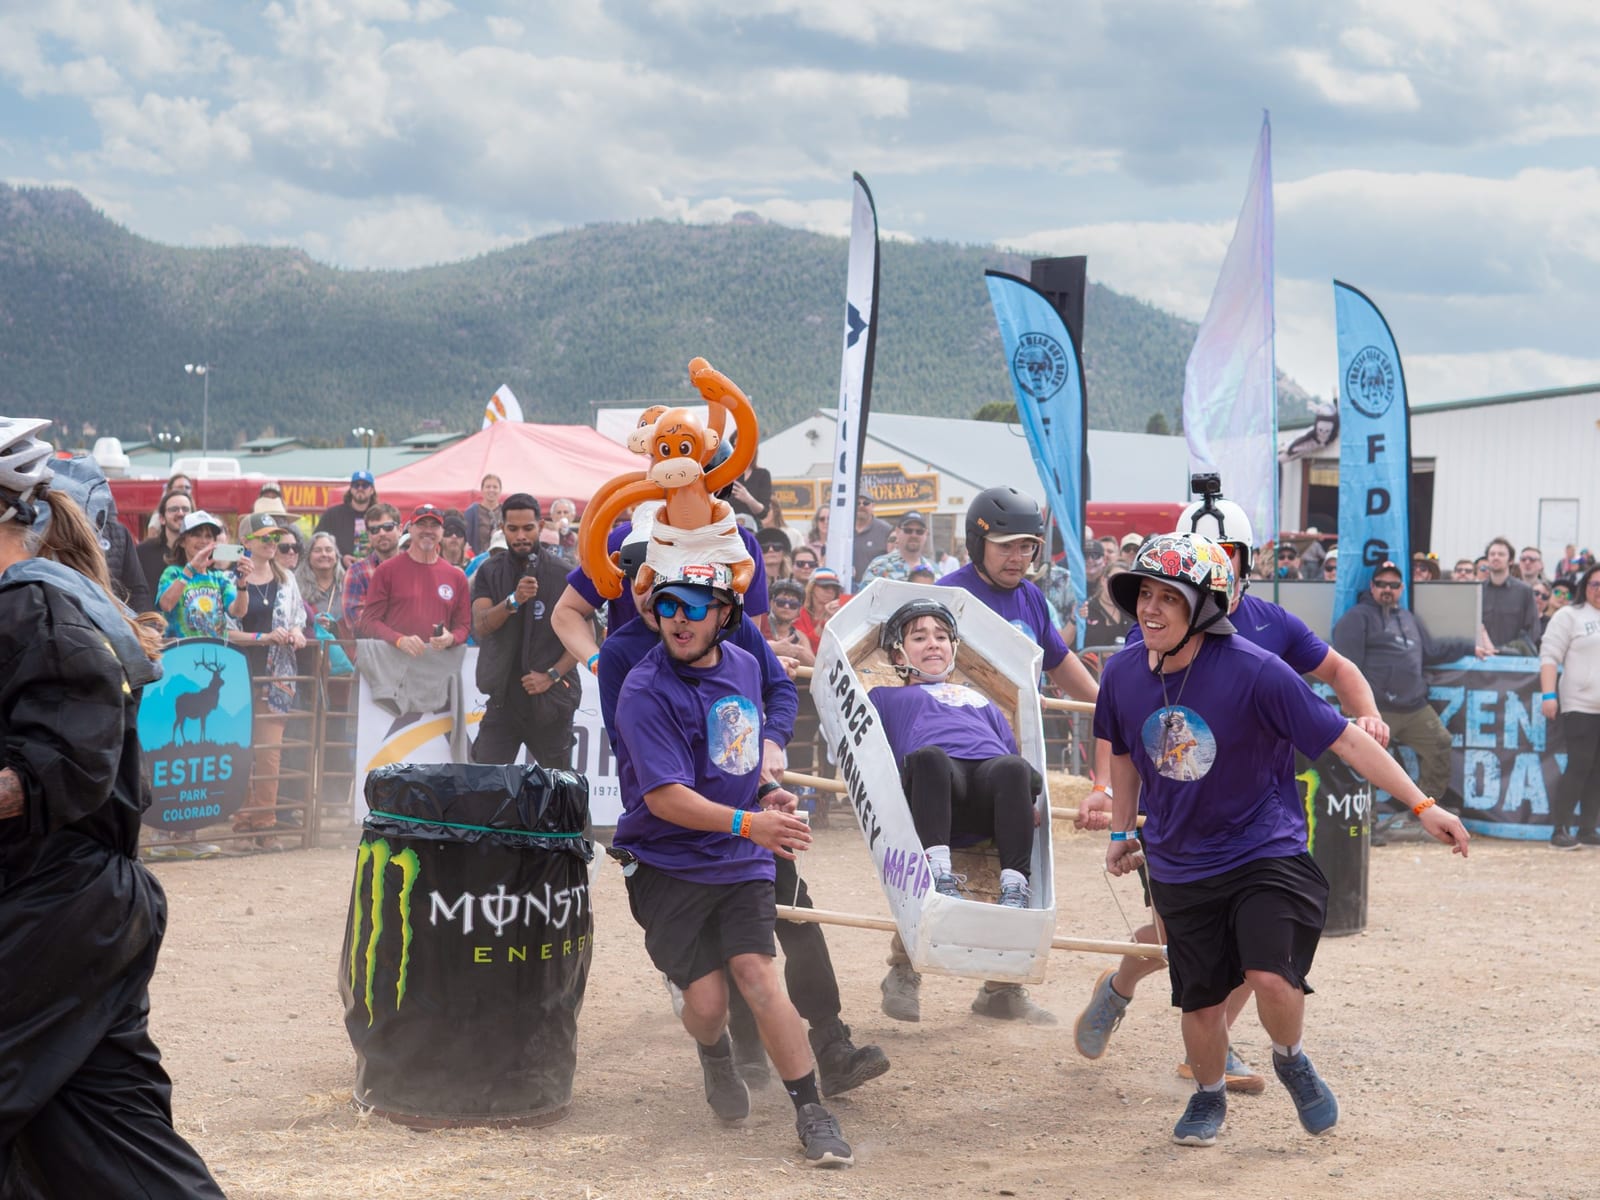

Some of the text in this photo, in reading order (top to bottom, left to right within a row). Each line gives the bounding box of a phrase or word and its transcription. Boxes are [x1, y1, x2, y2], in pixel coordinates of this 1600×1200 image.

[282, 485, 316, 507] YUM
[1428, 686, 1547, 752] ZEN
[153, 754, 233, 788] ESTES
[829, 658, 931, 899] SPACE MONKEY MAFIA
[179, 788, 208, 803] PARK
[163, 803, 221, 822] COLORADO
